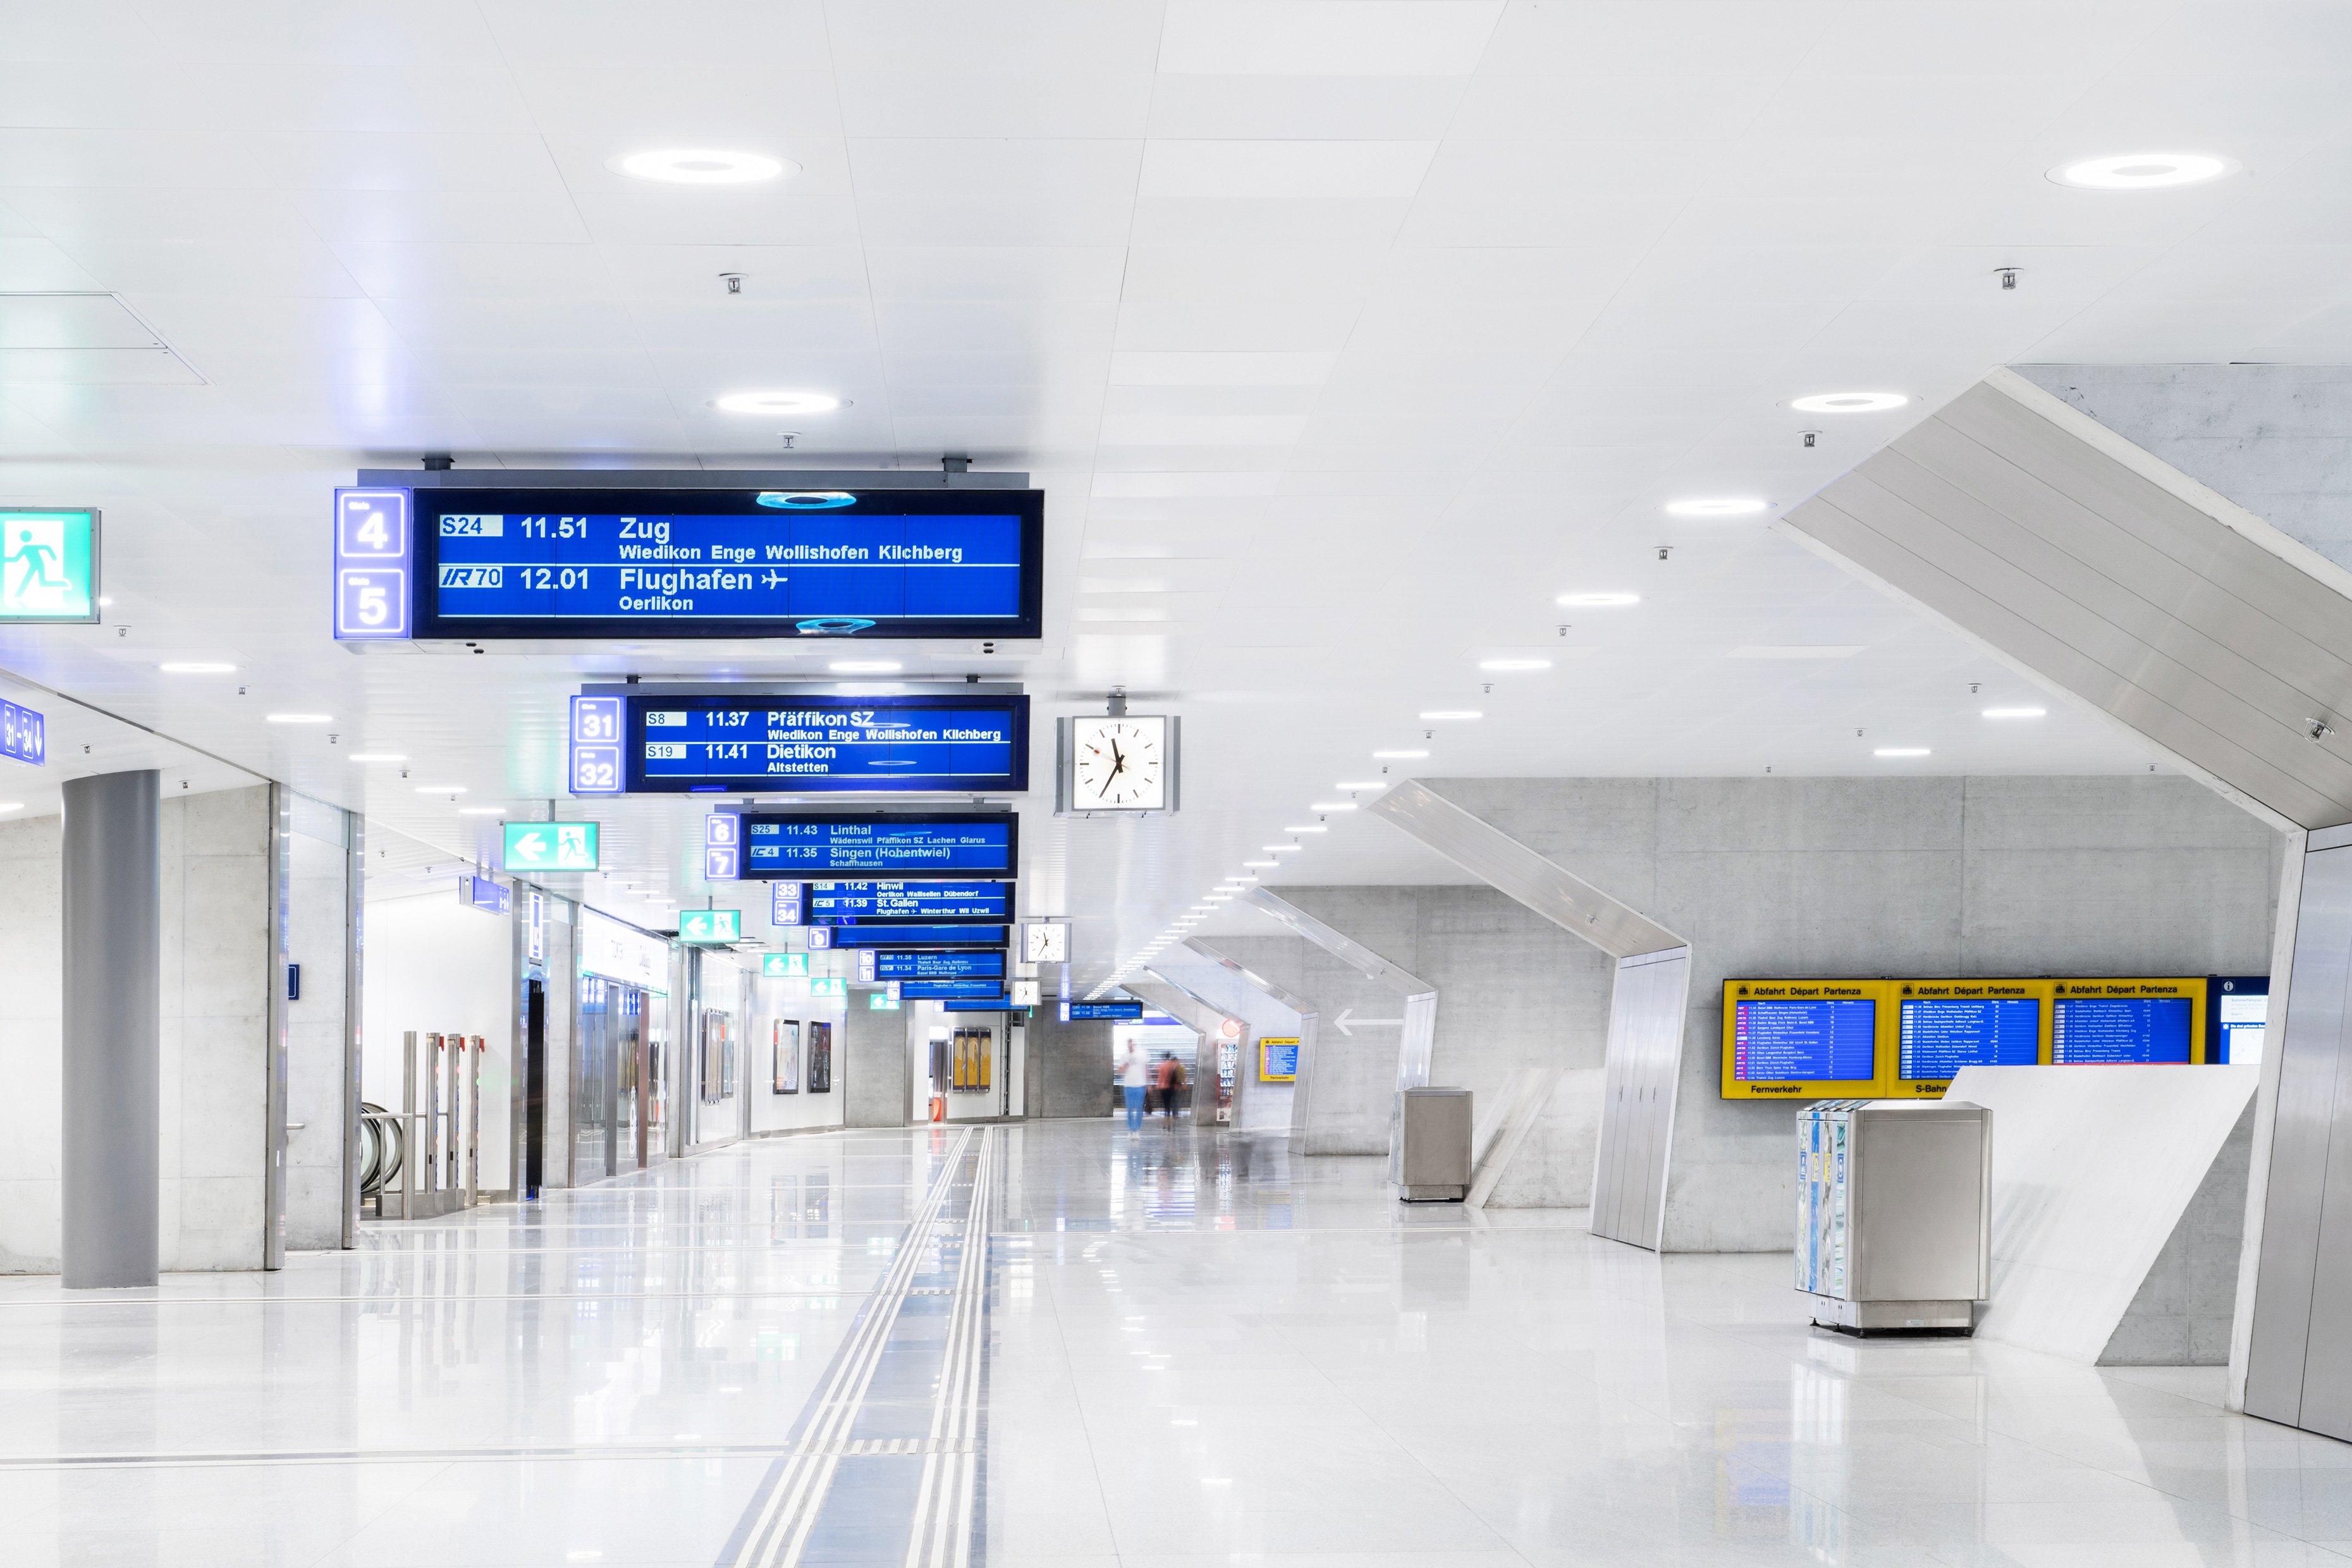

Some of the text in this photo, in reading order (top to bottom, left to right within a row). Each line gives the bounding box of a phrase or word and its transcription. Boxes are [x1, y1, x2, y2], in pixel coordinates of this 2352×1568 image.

[358, 513, 388, 549] 4
[443, 517, 670, 542] S24 11.51 Zug
[620, 545, 962, 563] Wiedikon Enge Wollishofen Kilchberg
[521, 568, 587, 589] 12.01
[621, 568, 752, 595] Flughafen
[359, 588, 386, 625] 5
[620, 596, 693, 610] Oerlikon
[649, 711, 874, 726] S8 11.37 Pfäffikon SZ
[584, 715, 612, 737] 31
[6, 723, 14, 747] 31
[24, 728, 32, 752] 34
[768, 729, 1001, 742] Wiedikon Enge Wollishofen Kilchberg
[648, 744, 836, 759] S19 11.41 Dietikon
[768, 763, 828, 772] Altstetten
[580, 764, 613, 785] 32
[716, 824, 728, 841] 6
[752, 825, 871, 835] S25 11.43 Linthal
[787, 847, 818, 857] 11.35
[830, 847, 872, 860] Singen
[875, 847, 950, 859] (Hohentwiel)
[715, 857, 728, 874] 7
[778, 884, 797, 896] 33
[845, 899, 867, 907] 11.39
[778, 909, 796, 922] 34
[814, 933, 824, 945] 9
[1791, 987, 1819, 996] Départ
[1824, 987, 1861, 995] Partenza
[1954, 986, 1983, 996] Départ
[1988, 986, 2025, 995] Partenza
[2107, 985, 2135, 995] Départ
[2140, 985, 2177, 993] Partenza
[1751, 1085, 1802, 1093] Fernverkehr
[1916, 1085, 1947, 1093] S-Bahn
